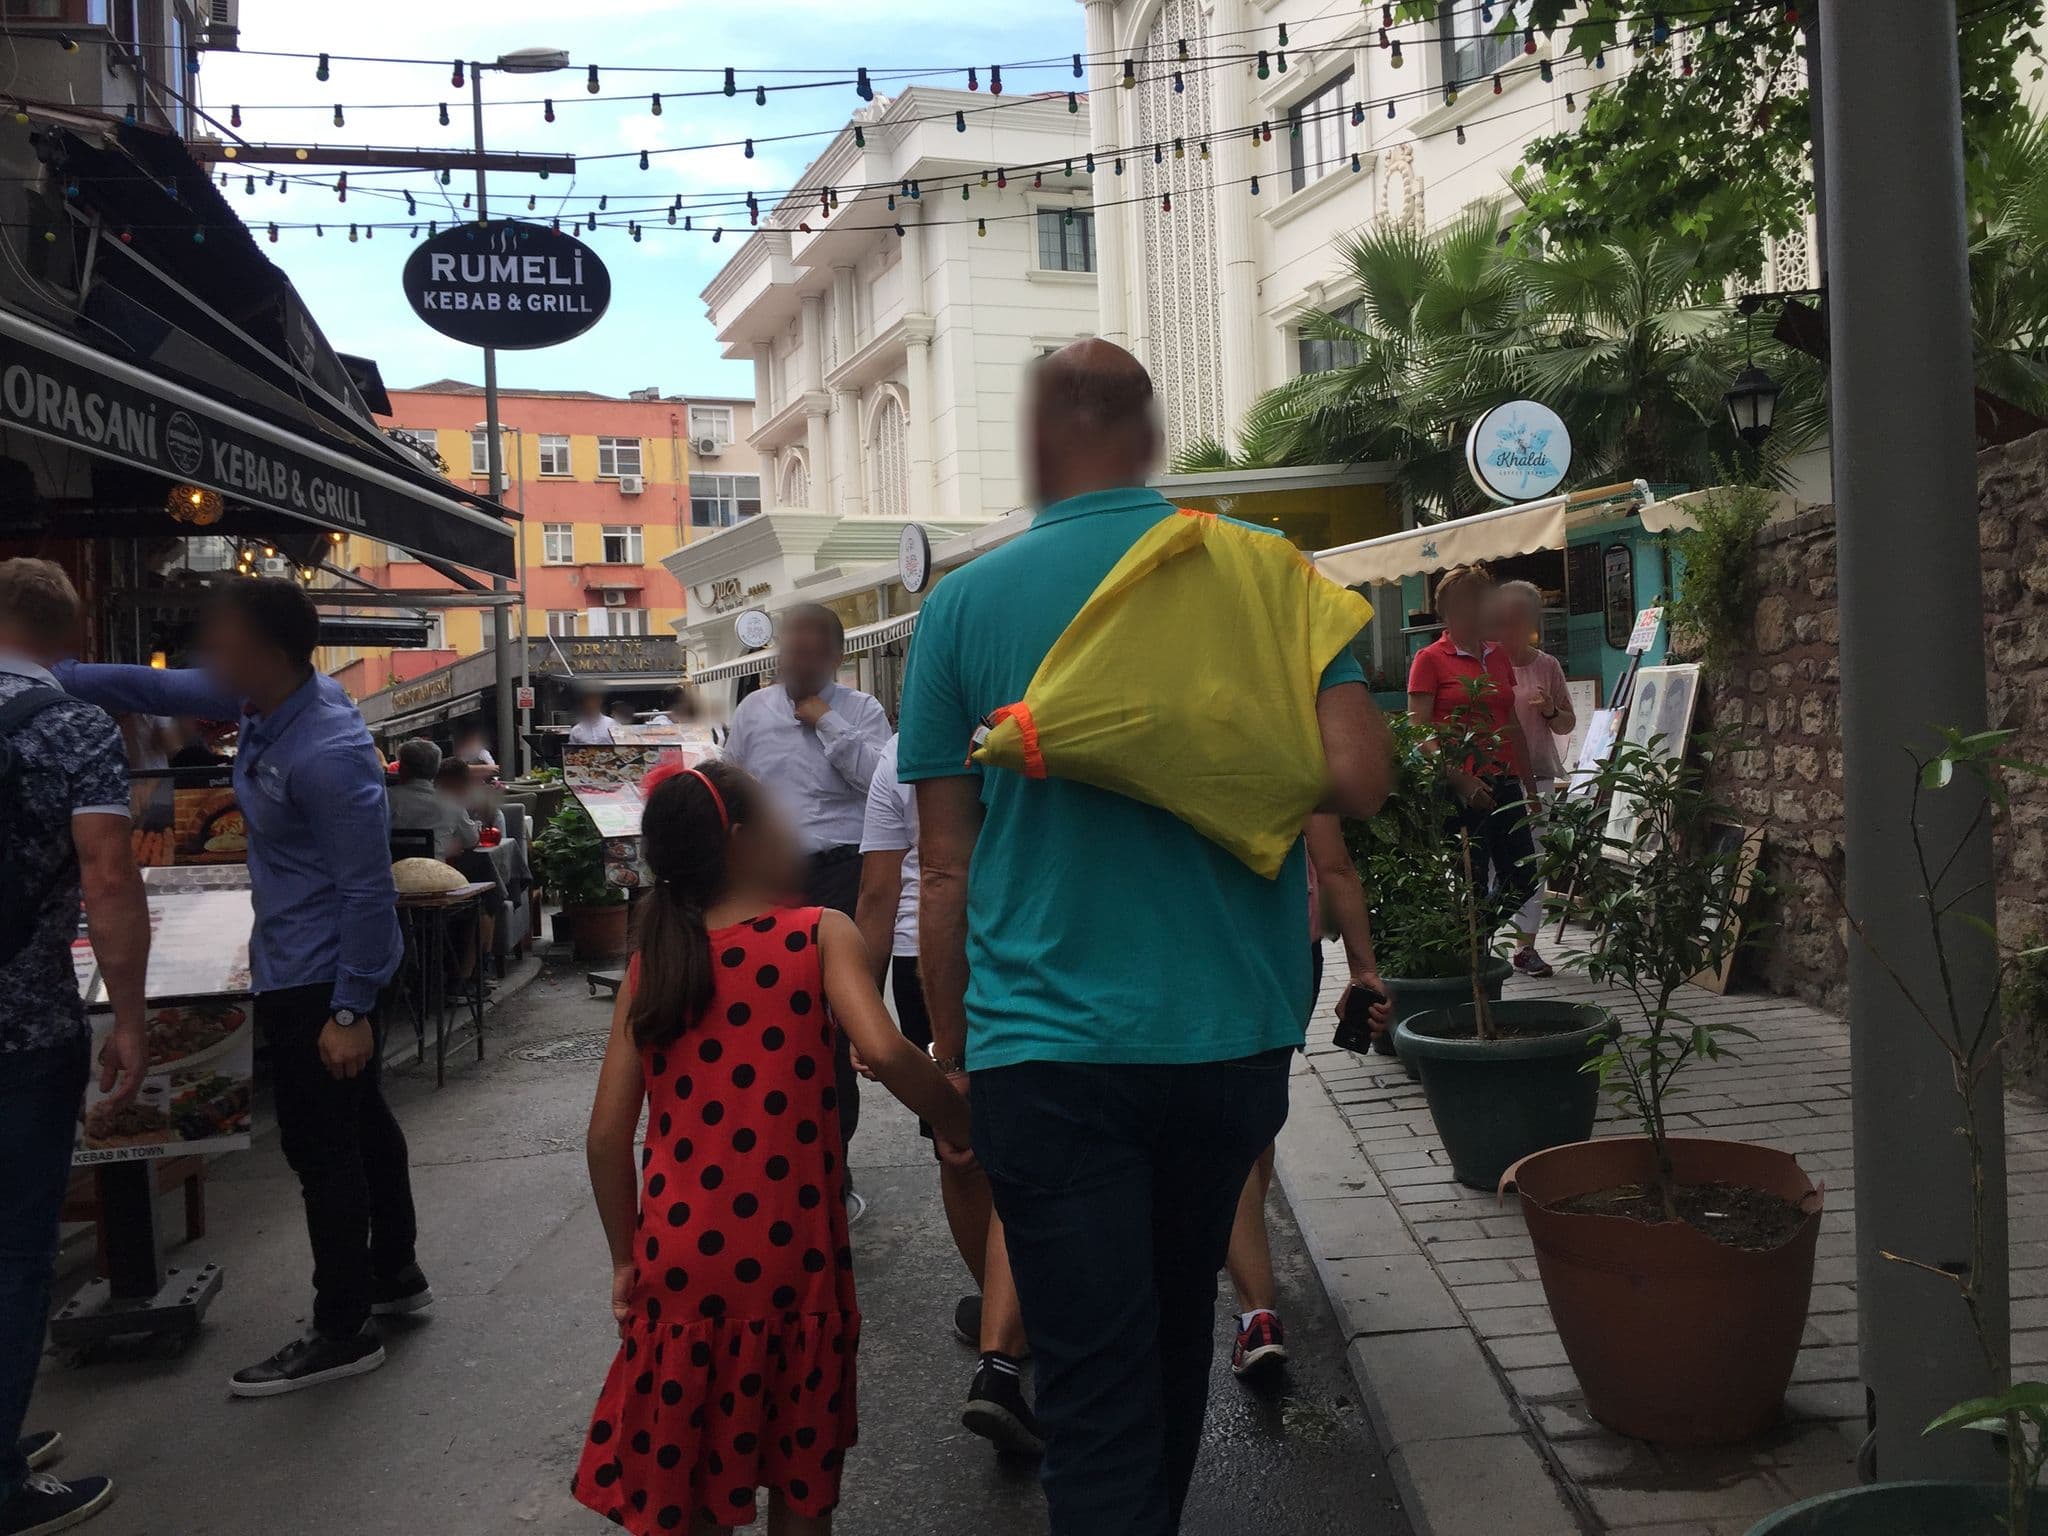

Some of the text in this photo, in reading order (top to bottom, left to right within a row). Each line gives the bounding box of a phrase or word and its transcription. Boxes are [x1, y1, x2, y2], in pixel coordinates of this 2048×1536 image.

[431, 248, 584, 286] RUMELİ
[423, 291, 593, 313] KEBAB & GRILL
[0, 364, 158, 460] ORASANİ
[211, 438, 287, 500] KEBAB
[291, 469, 307, 509] &
[310, 477, 367, 527] GRILL
[1497, 451, 1548, 468] Khaldi
[573, 643, 643, 657] DERALYE
[74, 1146, 165, 1164] KEBAB IN TOWN
